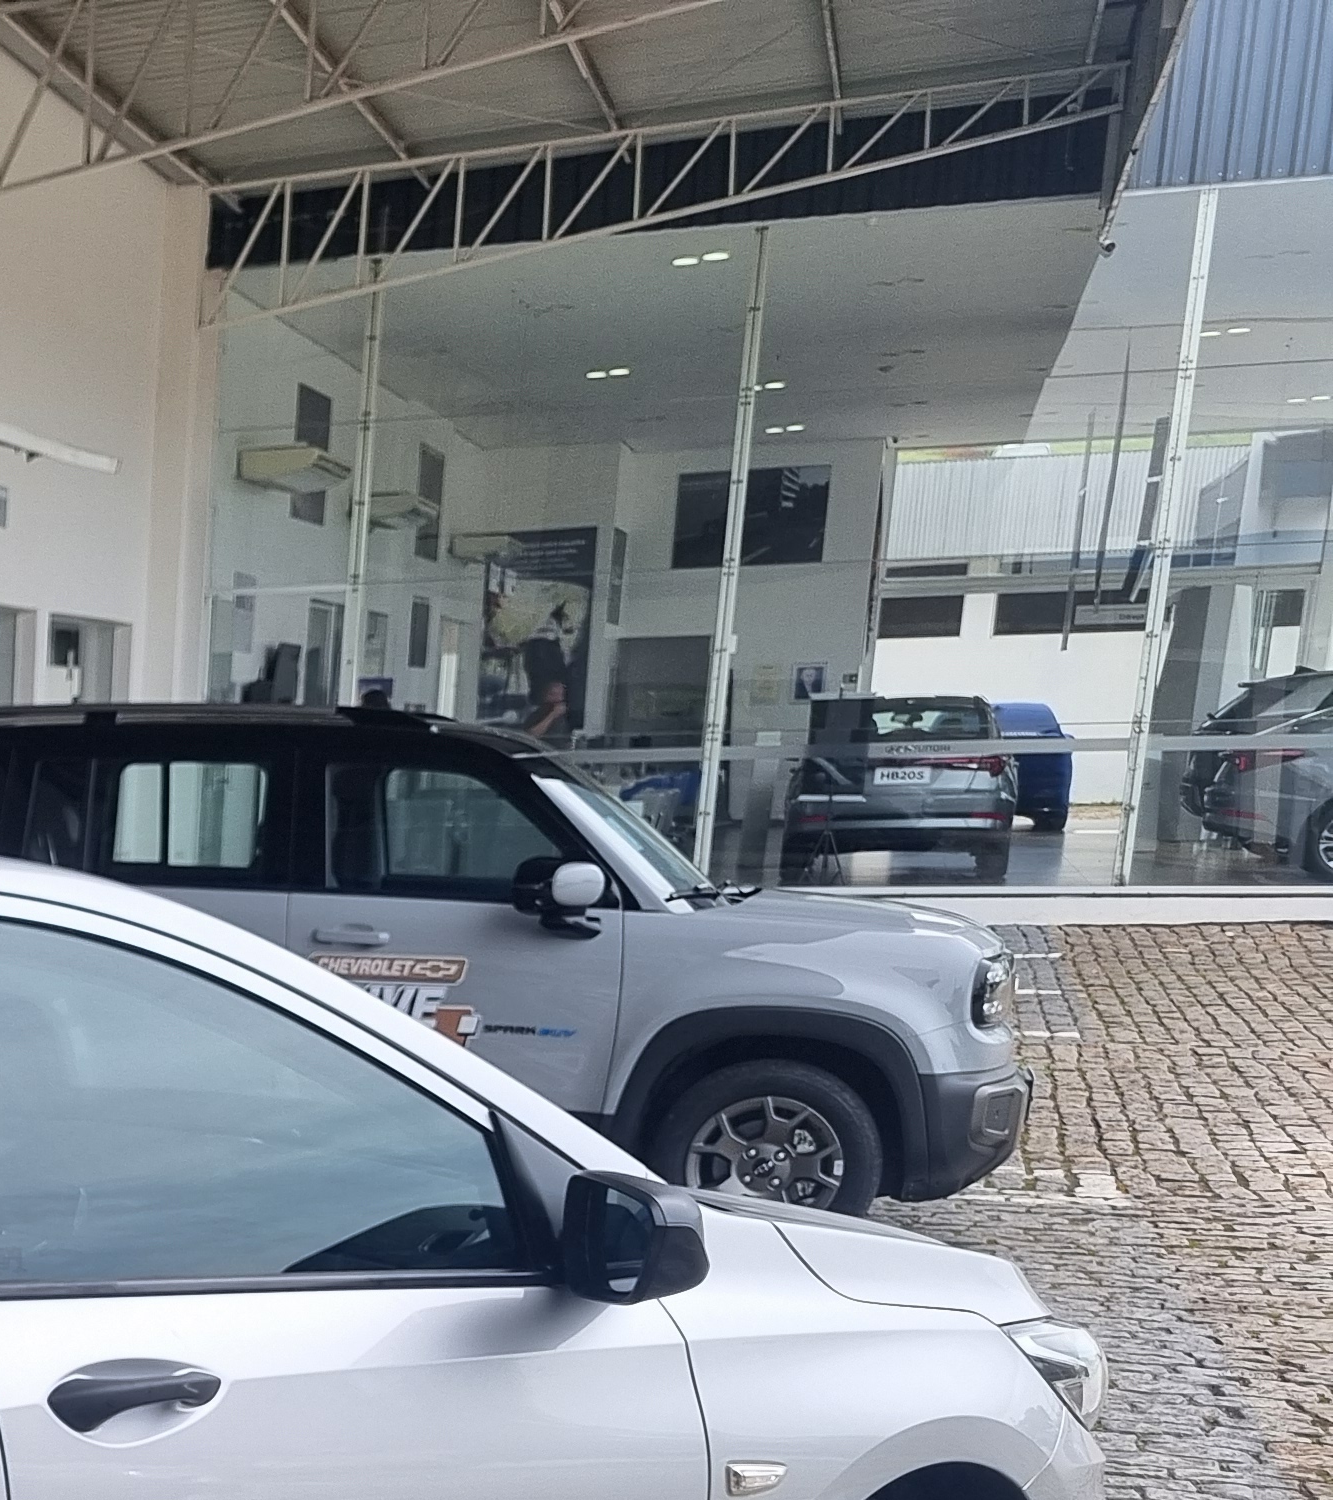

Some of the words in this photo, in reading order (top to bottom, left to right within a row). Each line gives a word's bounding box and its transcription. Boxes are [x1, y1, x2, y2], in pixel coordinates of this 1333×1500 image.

[880, 770, 925, 781] HB20S
[318, 957, 416, 977] CHEVROLET
[483, 1023, 536, 1036] SPARK
